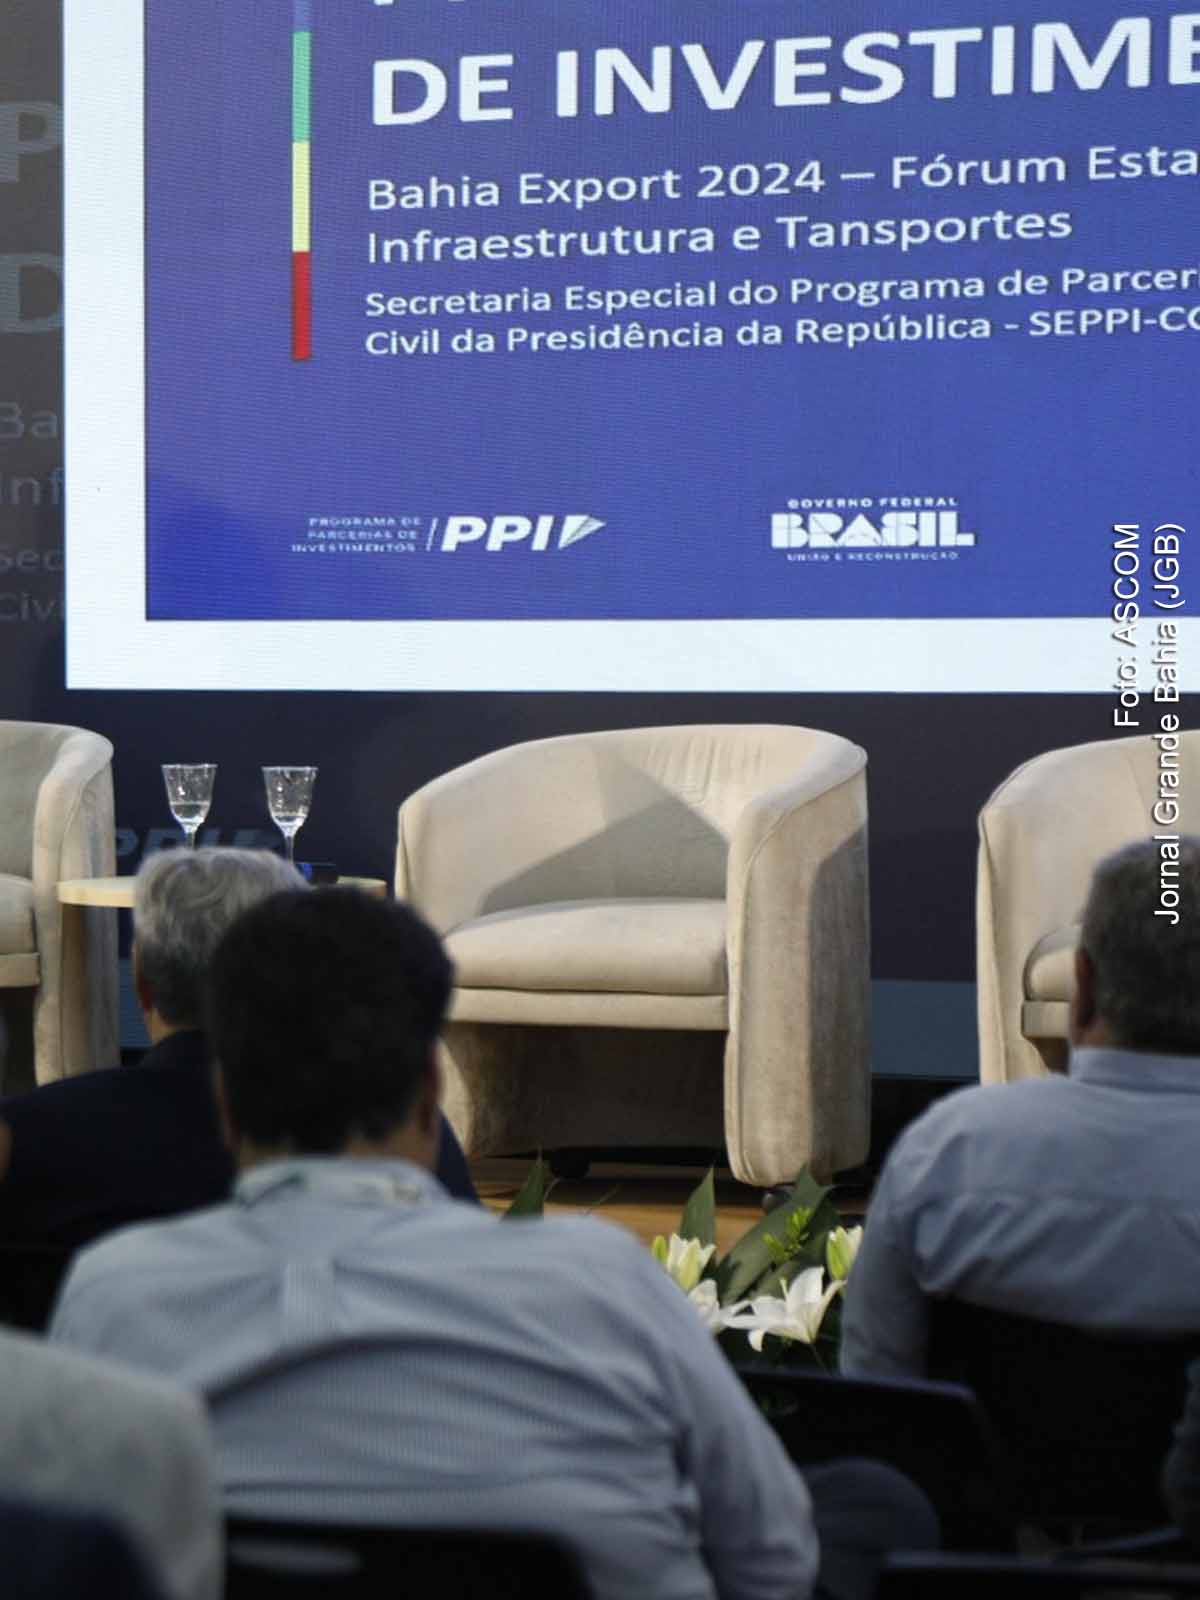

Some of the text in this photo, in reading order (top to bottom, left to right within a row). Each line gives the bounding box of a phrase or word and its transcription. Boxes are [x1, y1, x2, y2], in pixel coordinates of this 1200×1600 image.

[373, 14, 1200, 125] DE INVESTIME
[369, 175, 499, 210] Bahia
[519, 165, 681, 210] Export
[697, 160, 825, 197] 2024
[892, 153, 1066, 188] Fórum
[1088, 146, 1198, 180] Esta
[368, 210, 1073, 263] Infraestrutura e Tansportes
[365, 267, 1200, 317] Secretaria Especial do Programa de Parcer
[365, 328, 439, 354] Civil
[451, 328, 495, 352] da
[507, 321, 724, 350] Presidência
[736, 319, 782, 346] da
[796, 313, 991, 348] República
[787, 497, 957, 508] GOVERNO FEDERAL
[308, 517, 421, 527] PROGRAMA DE
[397, 530, 417, 540] DE
[441, 515, 554, 552] PPI
[771, 511, 975, 547] BRASIL
[291, 543, 416, 553] INVESTIMENTOS
